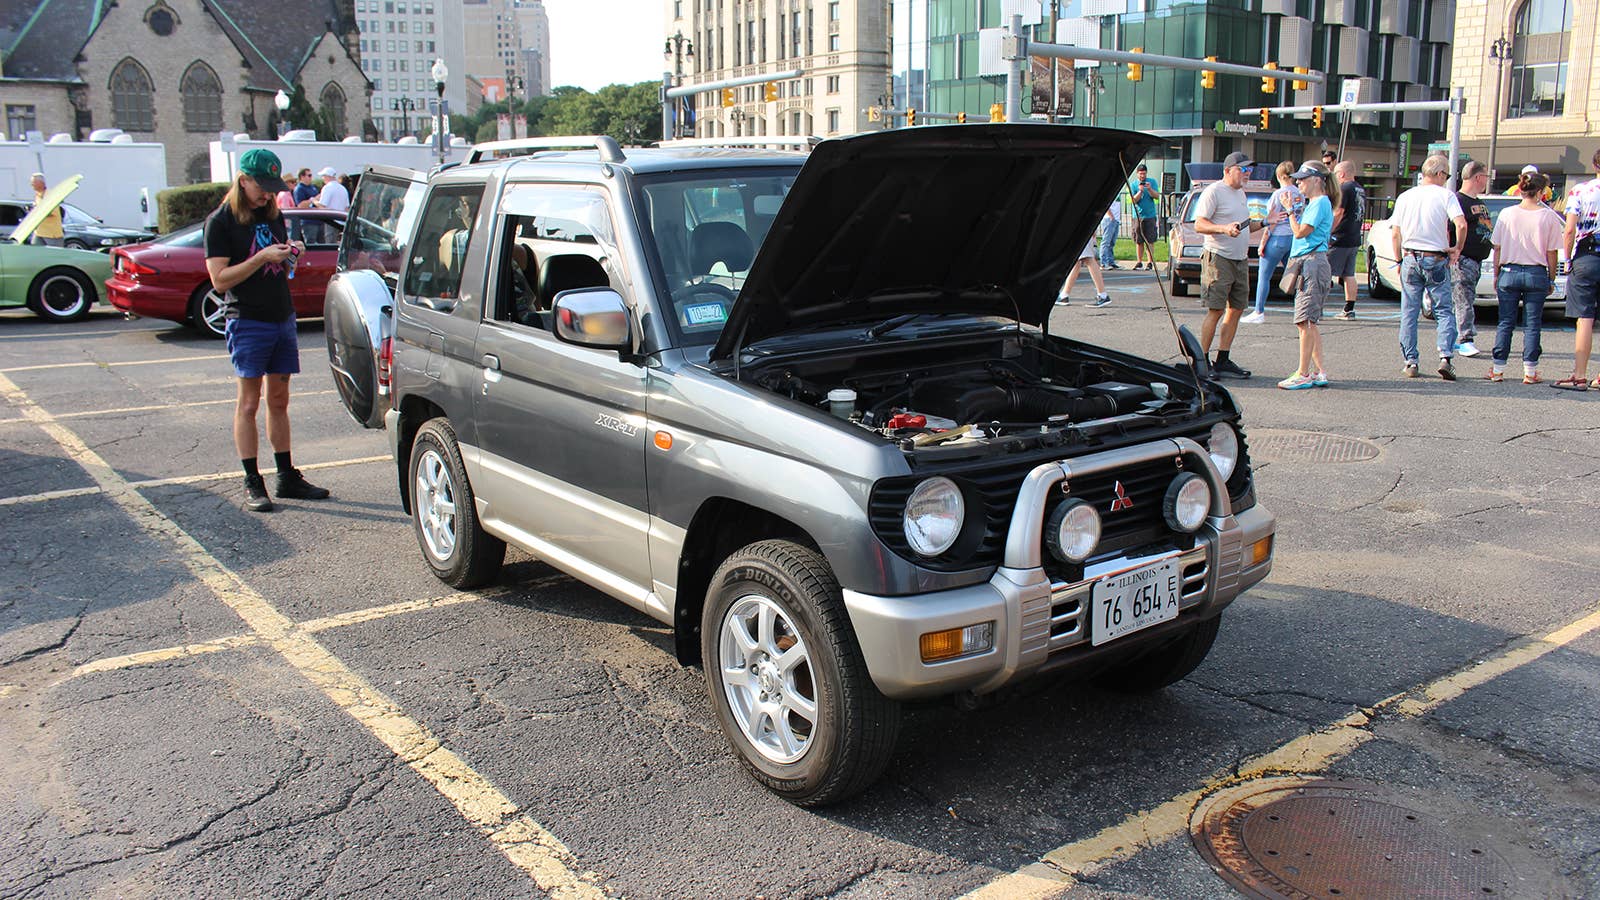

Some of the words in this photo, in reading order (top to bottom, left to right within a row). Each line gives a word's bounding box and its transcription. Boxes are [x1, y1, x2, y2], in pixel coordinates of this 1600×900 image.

[745, 568, 802, 613] DUNLOP
[1119, 568, 1157, 588] ILLINOIS
[1103, 595, 1122, 629] 76
[1133, 583, 1162, 618] 654
